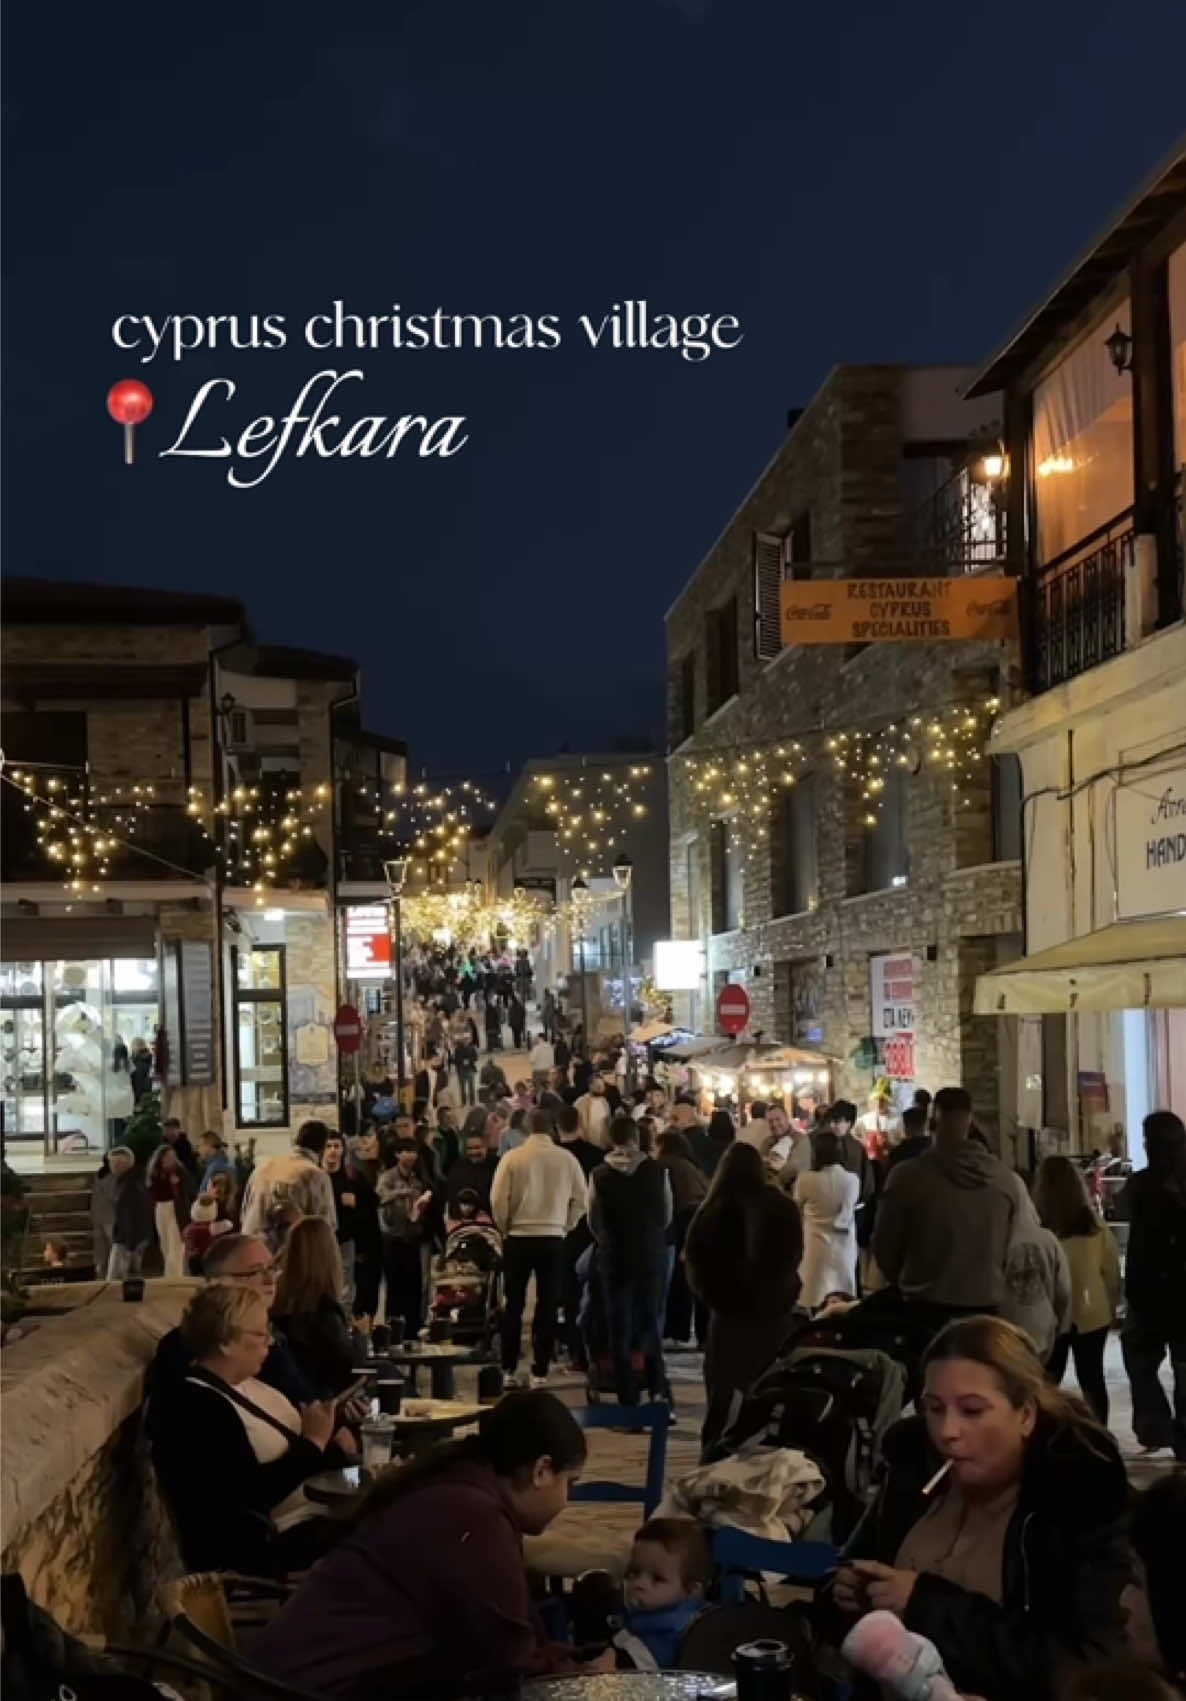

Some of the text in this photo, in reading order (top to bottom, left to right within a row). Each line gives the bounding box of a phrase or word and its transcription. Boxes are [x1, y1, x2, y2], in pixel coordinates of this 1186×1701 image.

[847, 582, 952, 600] RESTAURANT
[869, 602, 931, 619] CYPRUS
[852, 620, 950, 638] SPECIALITIES
